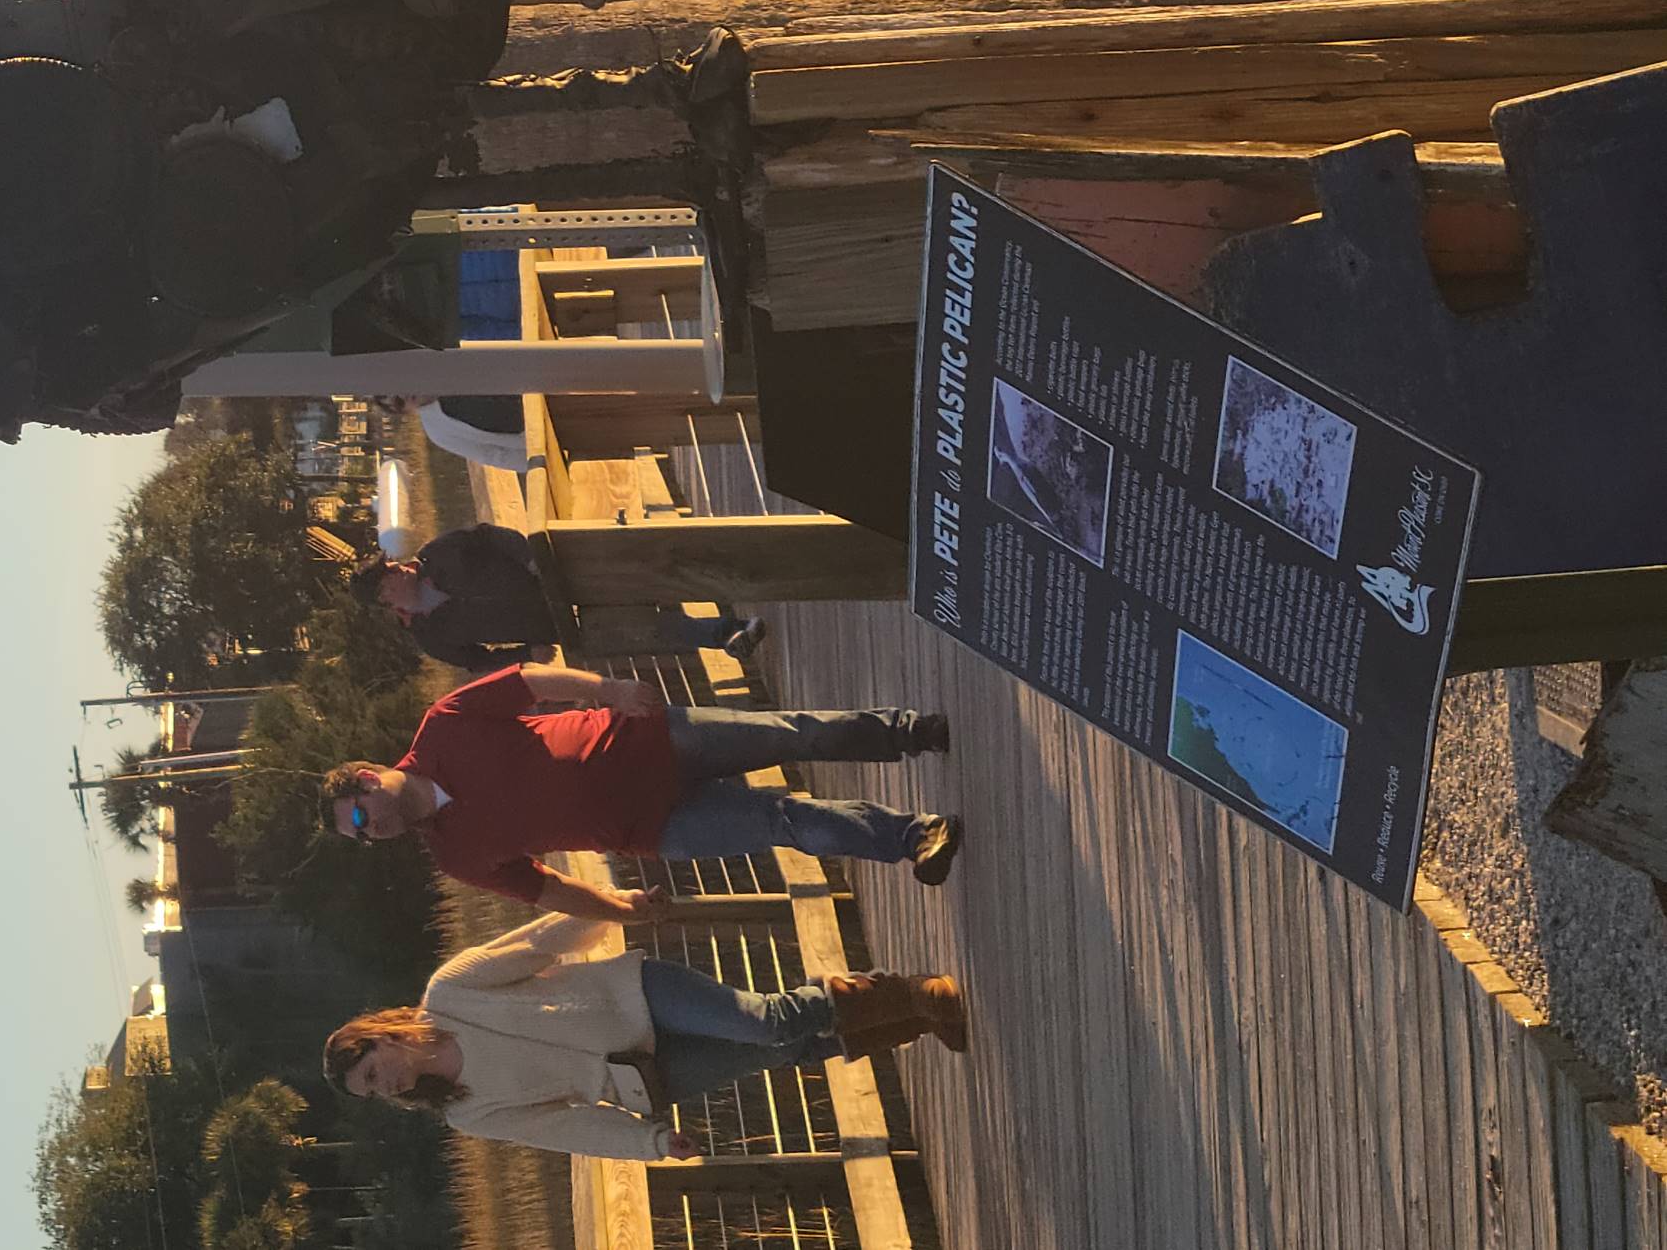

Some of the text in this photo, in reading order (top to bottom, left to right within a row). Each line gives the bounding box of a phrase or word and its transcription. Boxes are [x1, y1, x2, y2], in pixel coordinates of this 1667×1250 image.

[933, 192, 978, 628] Who is PETE do PLASTIC PELICAN?
[1390, 464, 1433, 572] Mount Pleasant SC
[1371, 765, 1399, 883] Reuse Reduce Recycle
